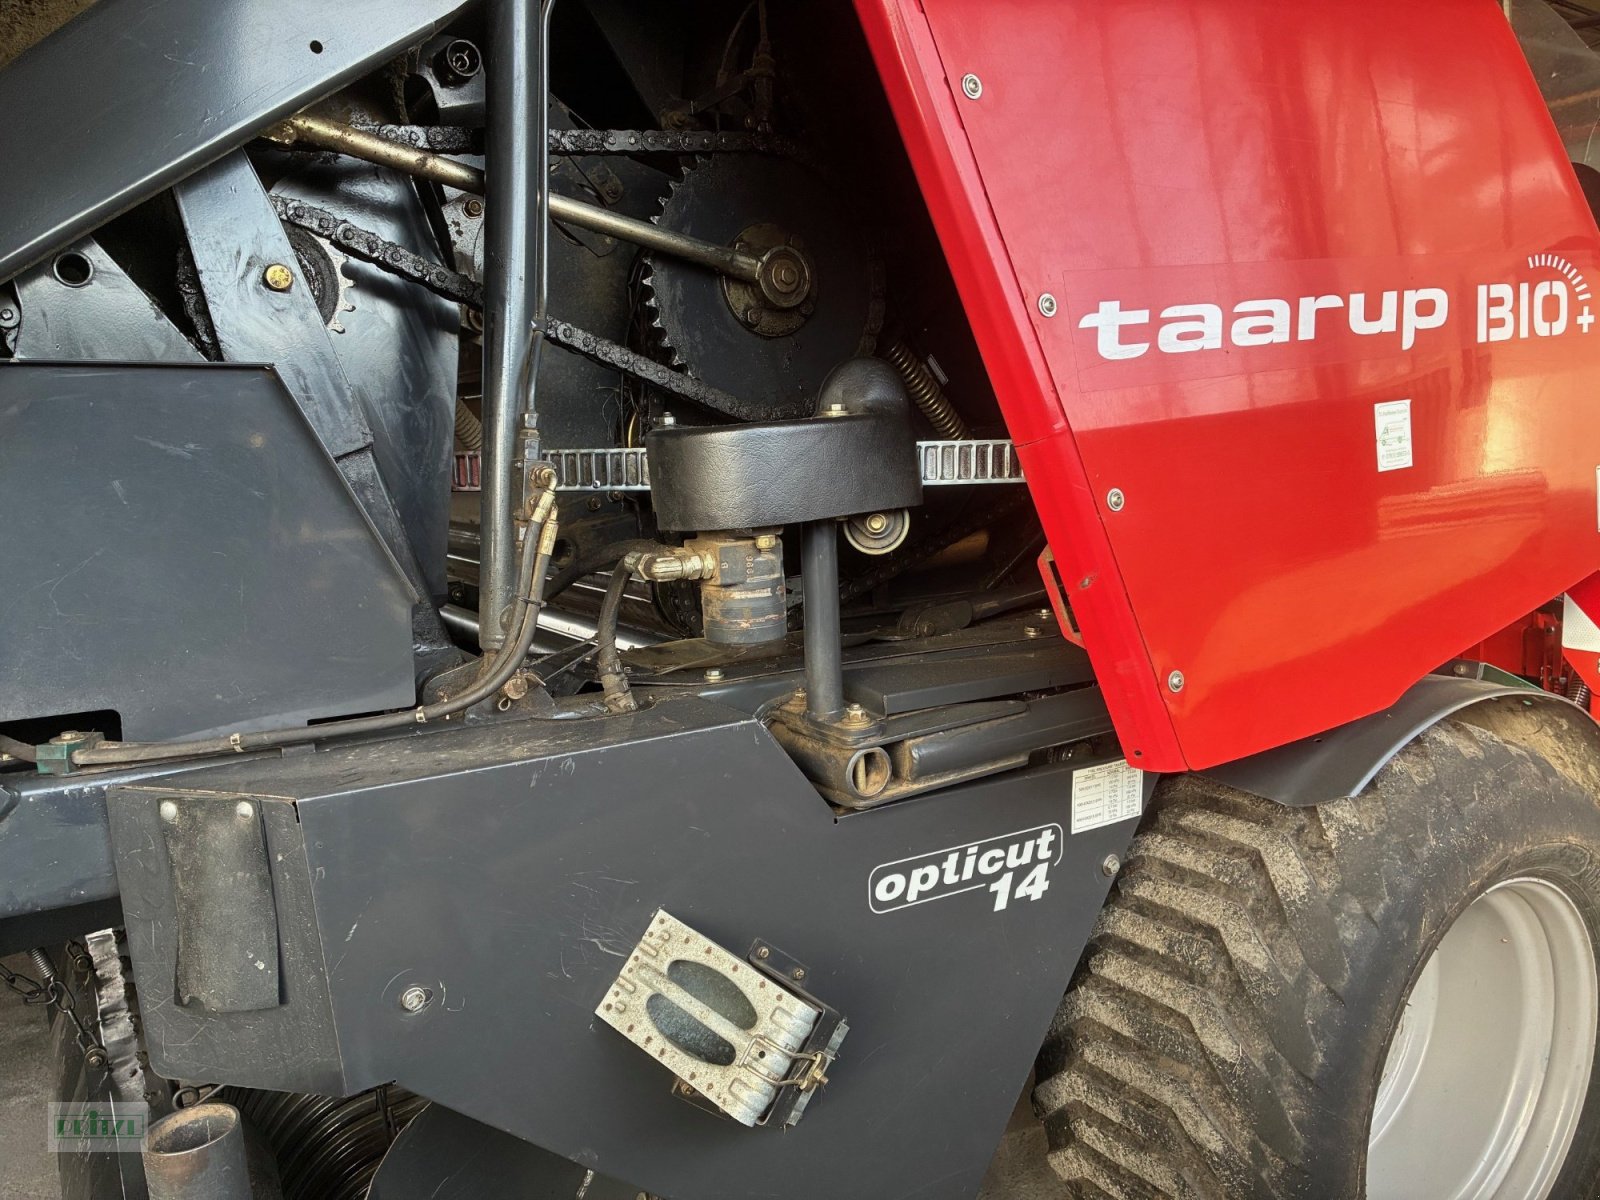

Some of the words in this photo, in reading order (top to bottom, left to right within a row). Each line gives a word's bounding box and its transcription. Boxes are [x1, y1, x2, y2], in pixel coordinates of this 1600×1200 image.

[1078, 287, 1449, 360] taarup
[874, 829, 1055, 902] opticut
[989, 862, 1050, 912] 14
